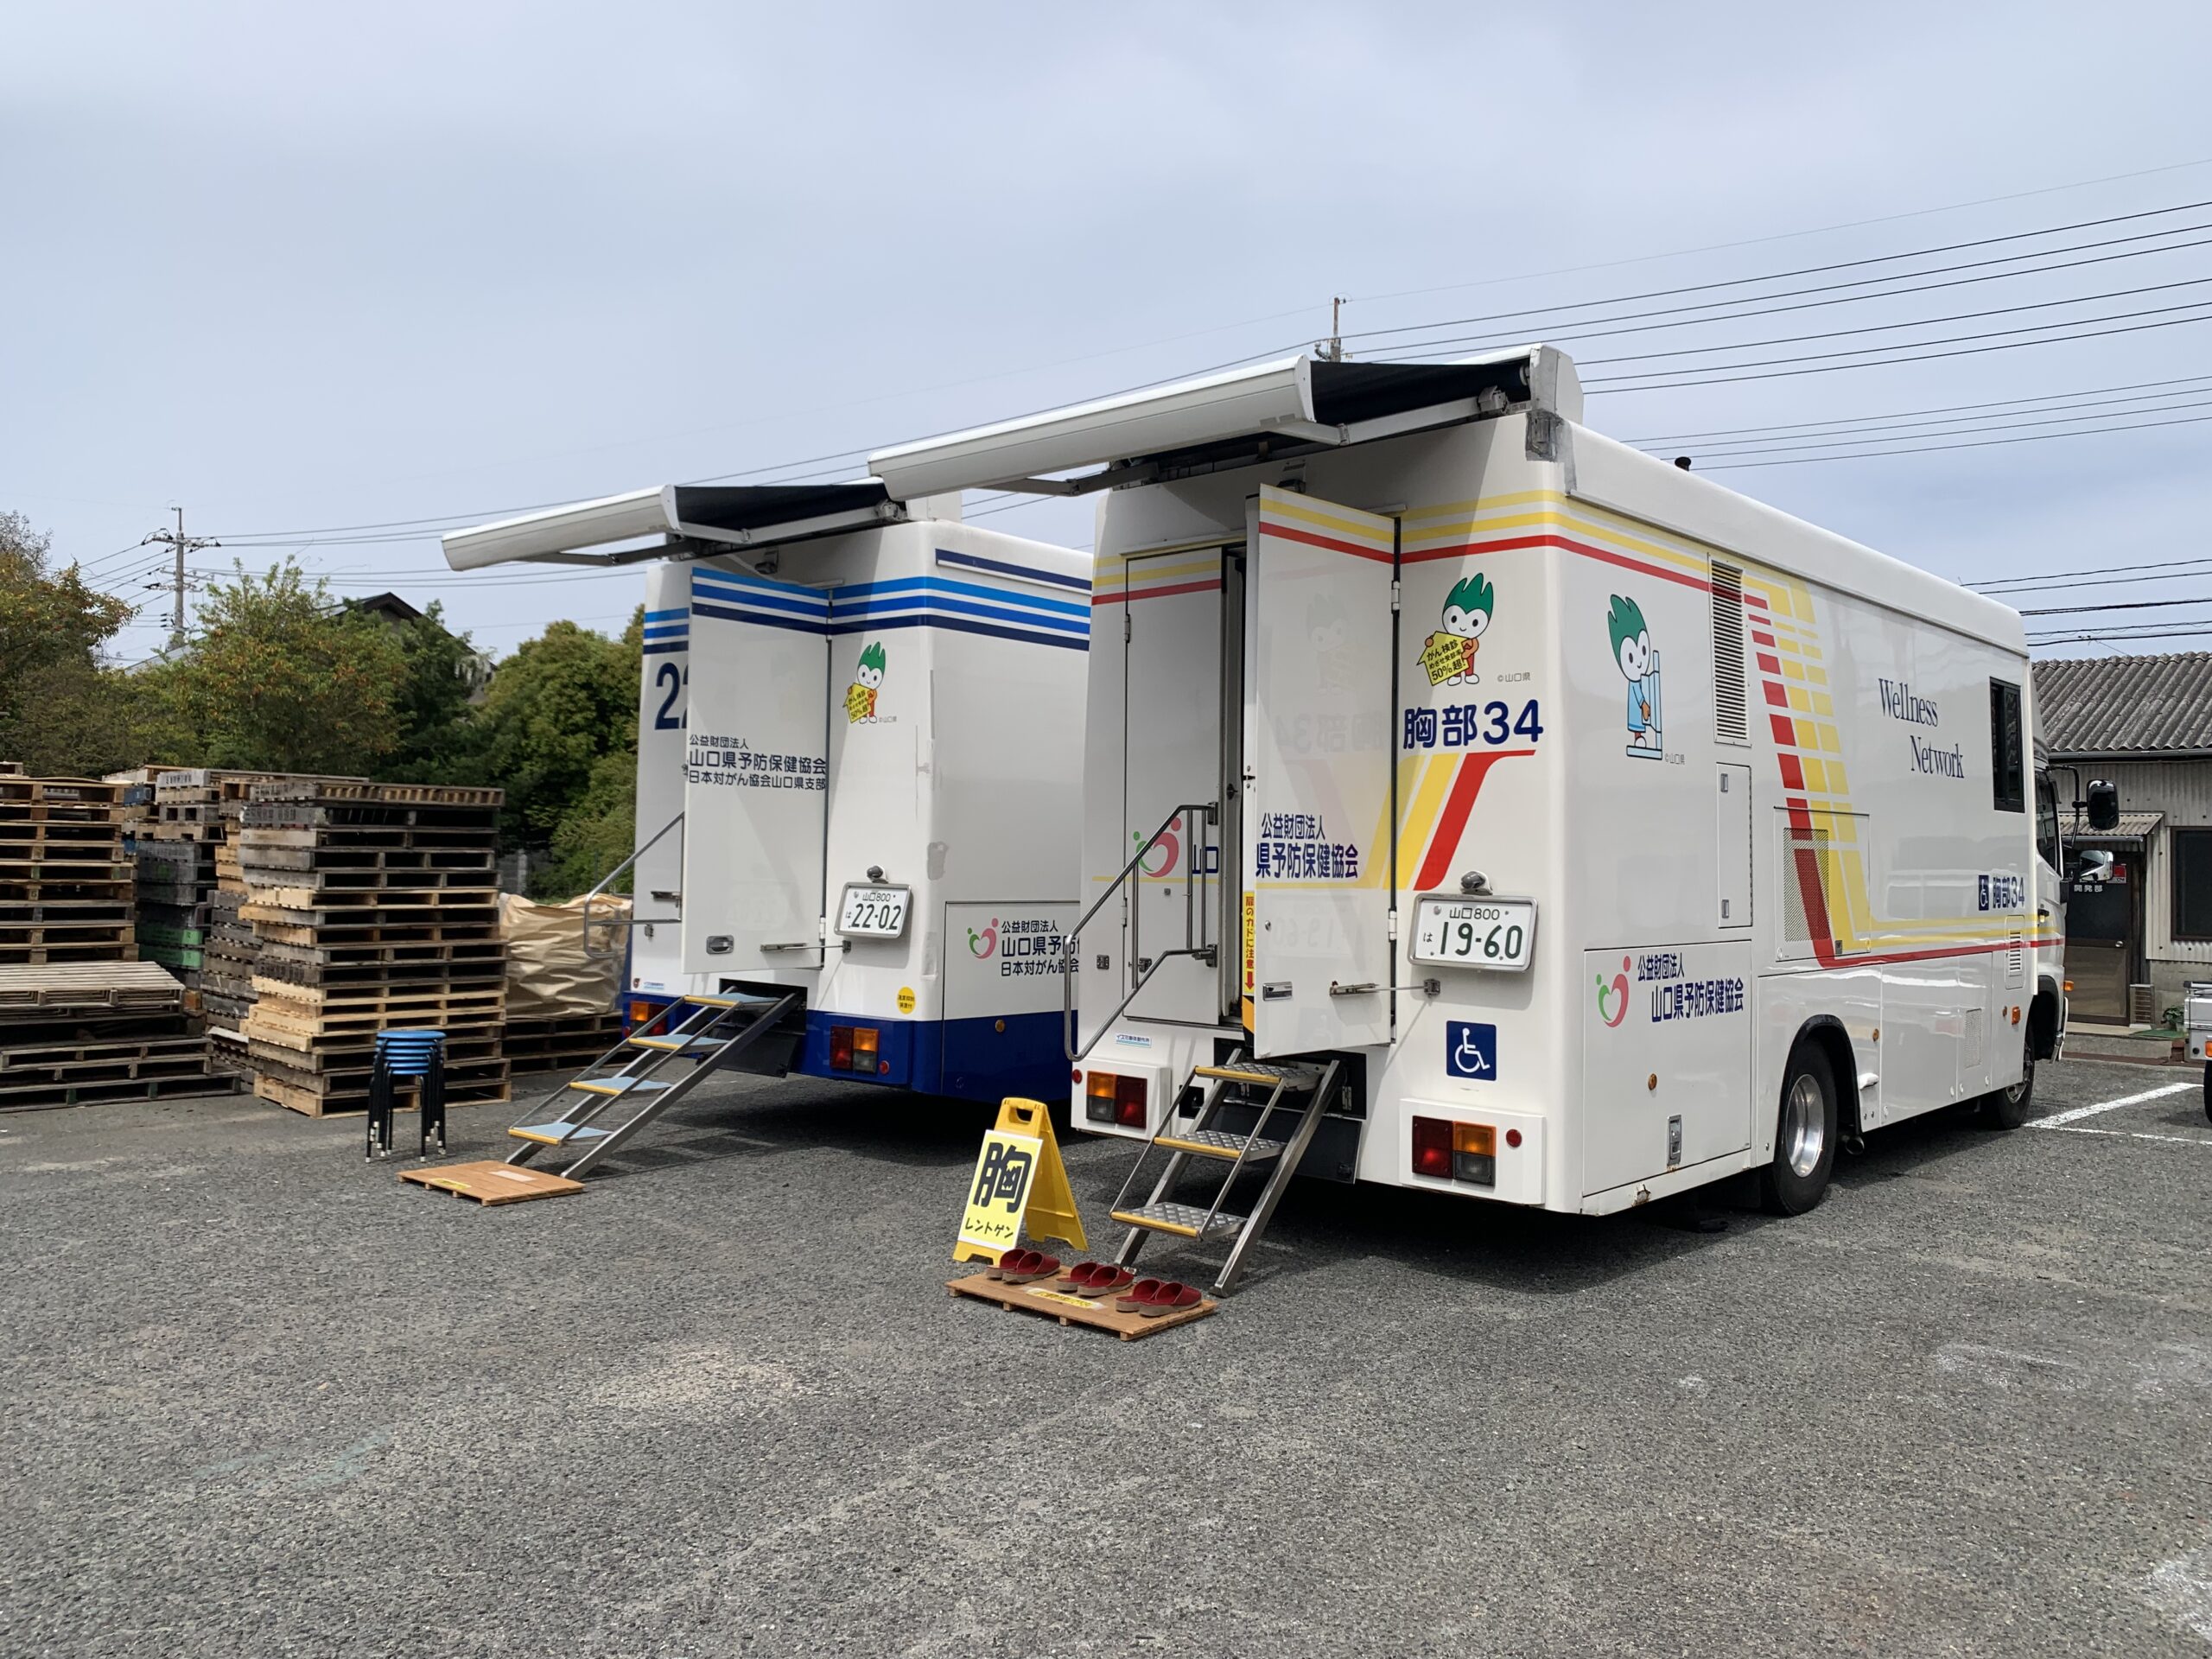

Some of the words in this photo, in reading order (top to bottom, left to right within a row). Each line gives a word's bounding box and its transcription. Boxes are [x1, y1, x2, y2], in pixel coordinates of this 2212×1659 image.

[1427, 639, 1459, 661] がん検診
[1878, 678, 1938, 727] Wellness
[1403, 699, 1544, 749] 胸部34
[689, 734, 749, 750] 公益財団法人
[1910, 735, 1965, 779] Network
[690, 748, 827, 775] 山口県予防保健協会
[689, 770, 827, 791] 日本対がん協会山口県支部
[1262, 812, 1326, 841] 公益財団法人
[1255, 842, 1358, 879] 県予防保健協会
[1993, 876, 2025, 909] 胸部34
[1001, 919, 1058, 934] 公益財団法人
[1245, 896, 1255, 969] 扉のカドに注意
[1423, 932, 1433, 943] は
[1440, 921, 1522, 959] 19-60
[1637, 952, 1685, 982] 公益財団法人
[1652, 977, 1744, 1023] 山口県予防保健協会
[973, 1141, 1033, 1213] 胸
[964, 1217, 1014, 1239] レントゲン
